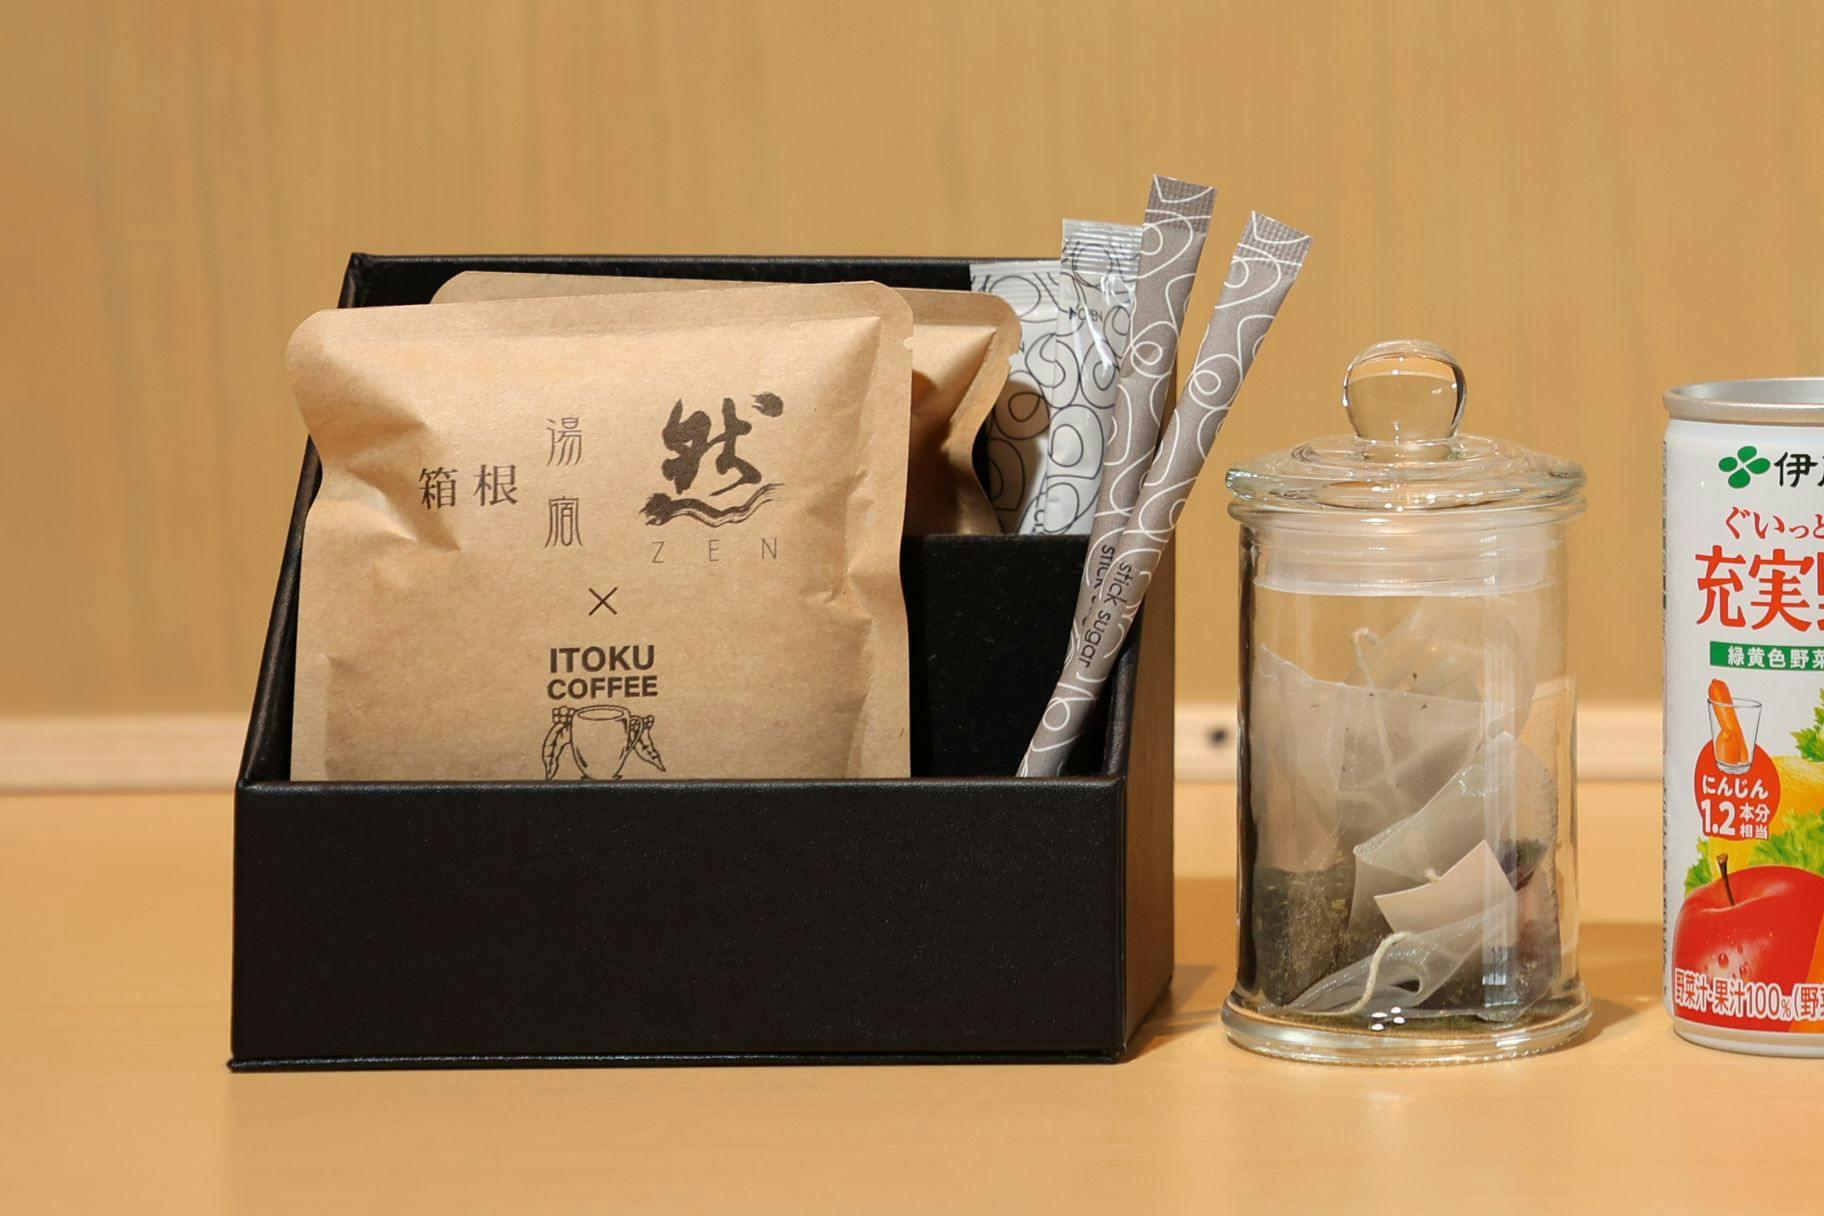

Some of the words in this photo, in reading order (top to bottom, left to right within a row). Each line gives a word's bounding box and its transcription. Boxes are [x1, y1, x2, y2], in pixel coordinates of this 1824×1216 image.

[418, 463, 519, 511] 箱根
[651, 536, 779, 564] ZEN
[1103, 562, 1133, 606] stick
[1079, 609, 1111, 668] sugar
[549, 644, 656, 674] ITOKU
[546, 674, 659, 700] COFFEE
[1702, 774, 1769, 800] にんじん
[1701, 799, 1736, 836] 1.2
[1740, 802, 1771, 823] 本分
[1739, 823, 1769, 839] 相当
